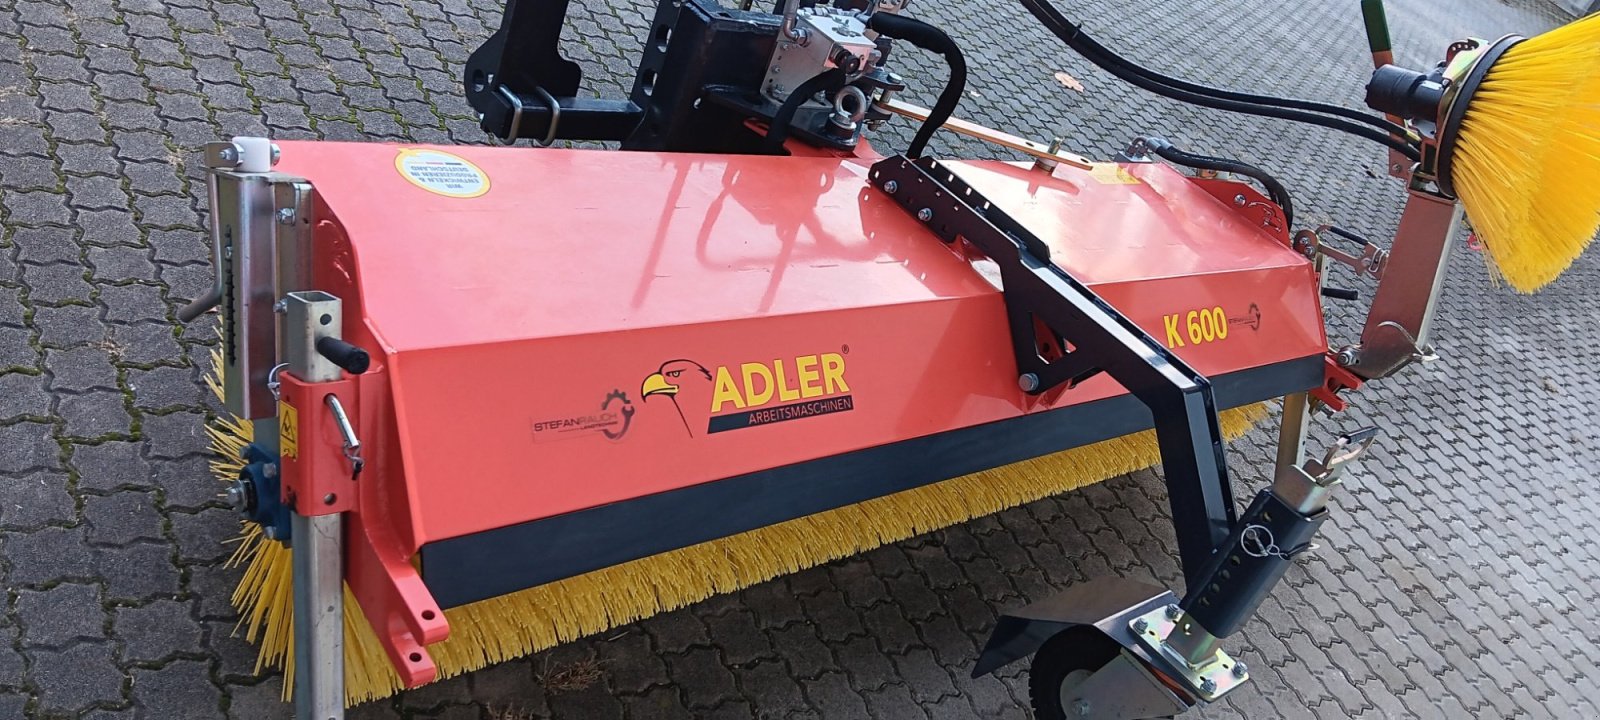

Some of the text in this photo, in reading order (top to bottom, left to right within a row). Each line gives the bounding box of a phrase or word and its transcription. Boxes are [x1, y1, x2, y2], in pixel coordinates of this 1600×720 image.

[1163, 306, 1228, 349] K 600
[711, 352, 850, 413] ADLER
[748, 398, 852, 425] ARBEITSMASCHINEN
